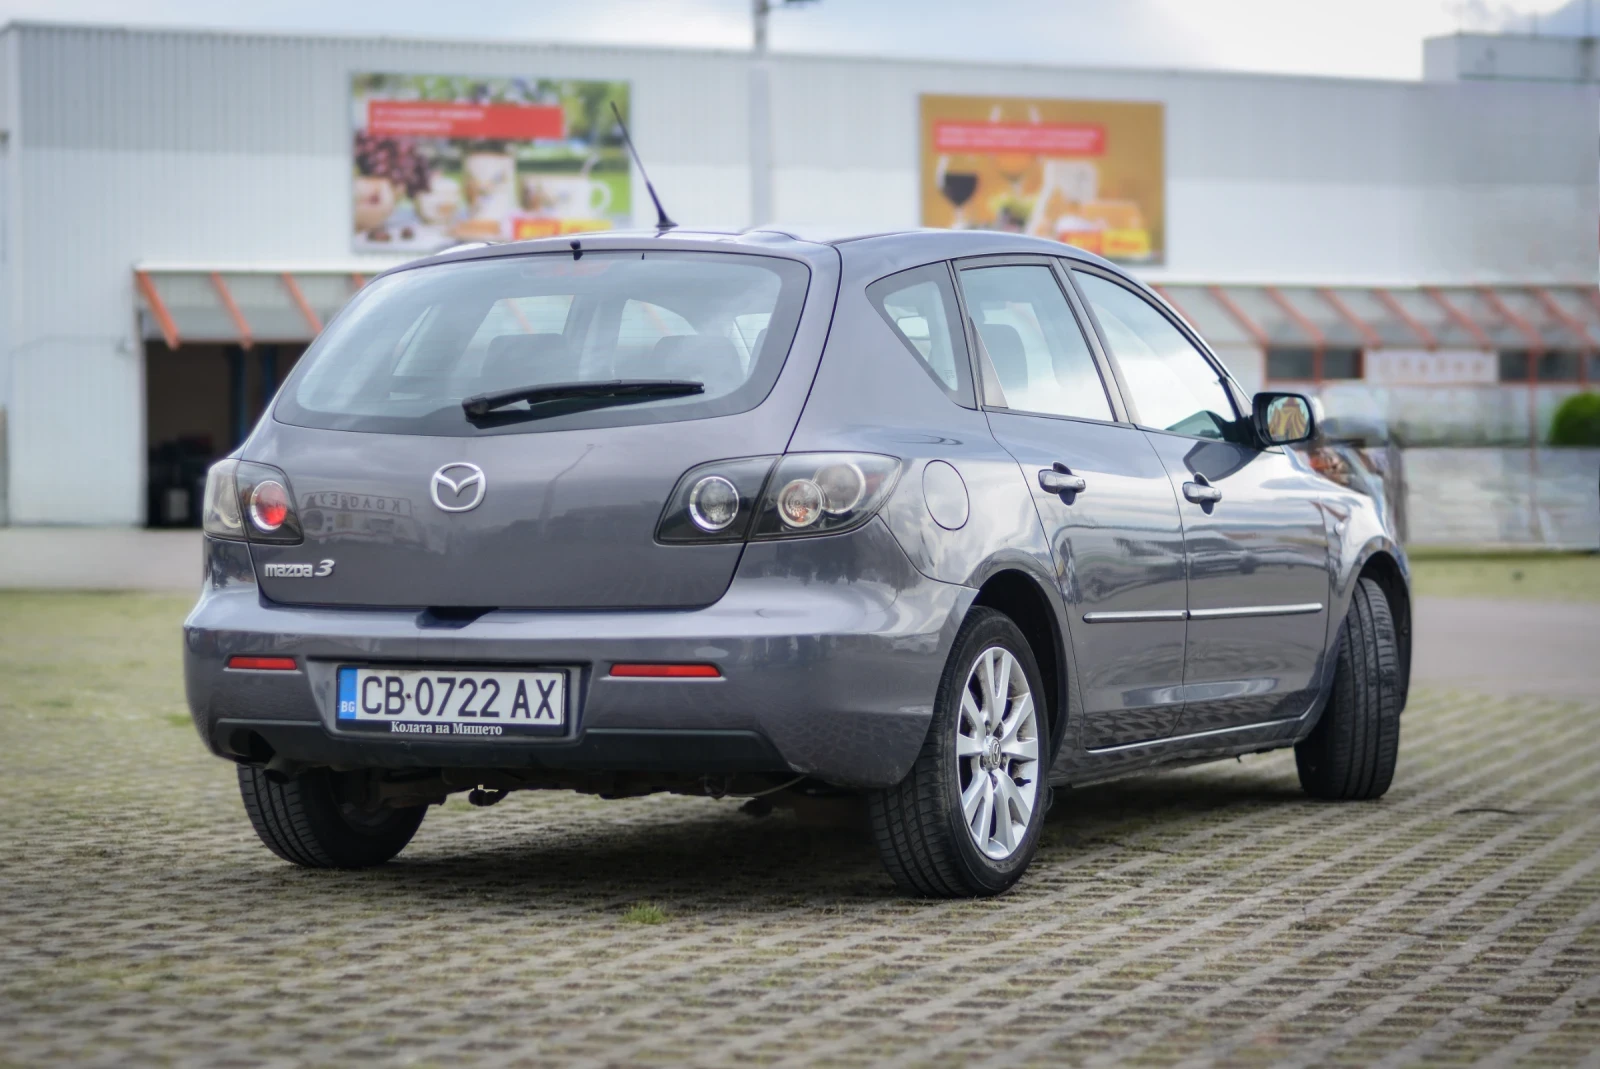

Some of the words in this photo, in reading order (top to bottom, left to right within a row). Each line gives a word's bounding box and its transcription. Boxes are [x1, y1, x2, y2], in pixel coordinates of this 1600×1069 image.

[314, 558, 335, 577] 3
[415, 677, 500, 718] 0722
[510, 679, 557, 719] AX
[341, 701, 355, 713] BG
[391, 721, 432, 734] Колата
[435, 724, 449, 735] на
[453, 723, 502, 736] Мишето
